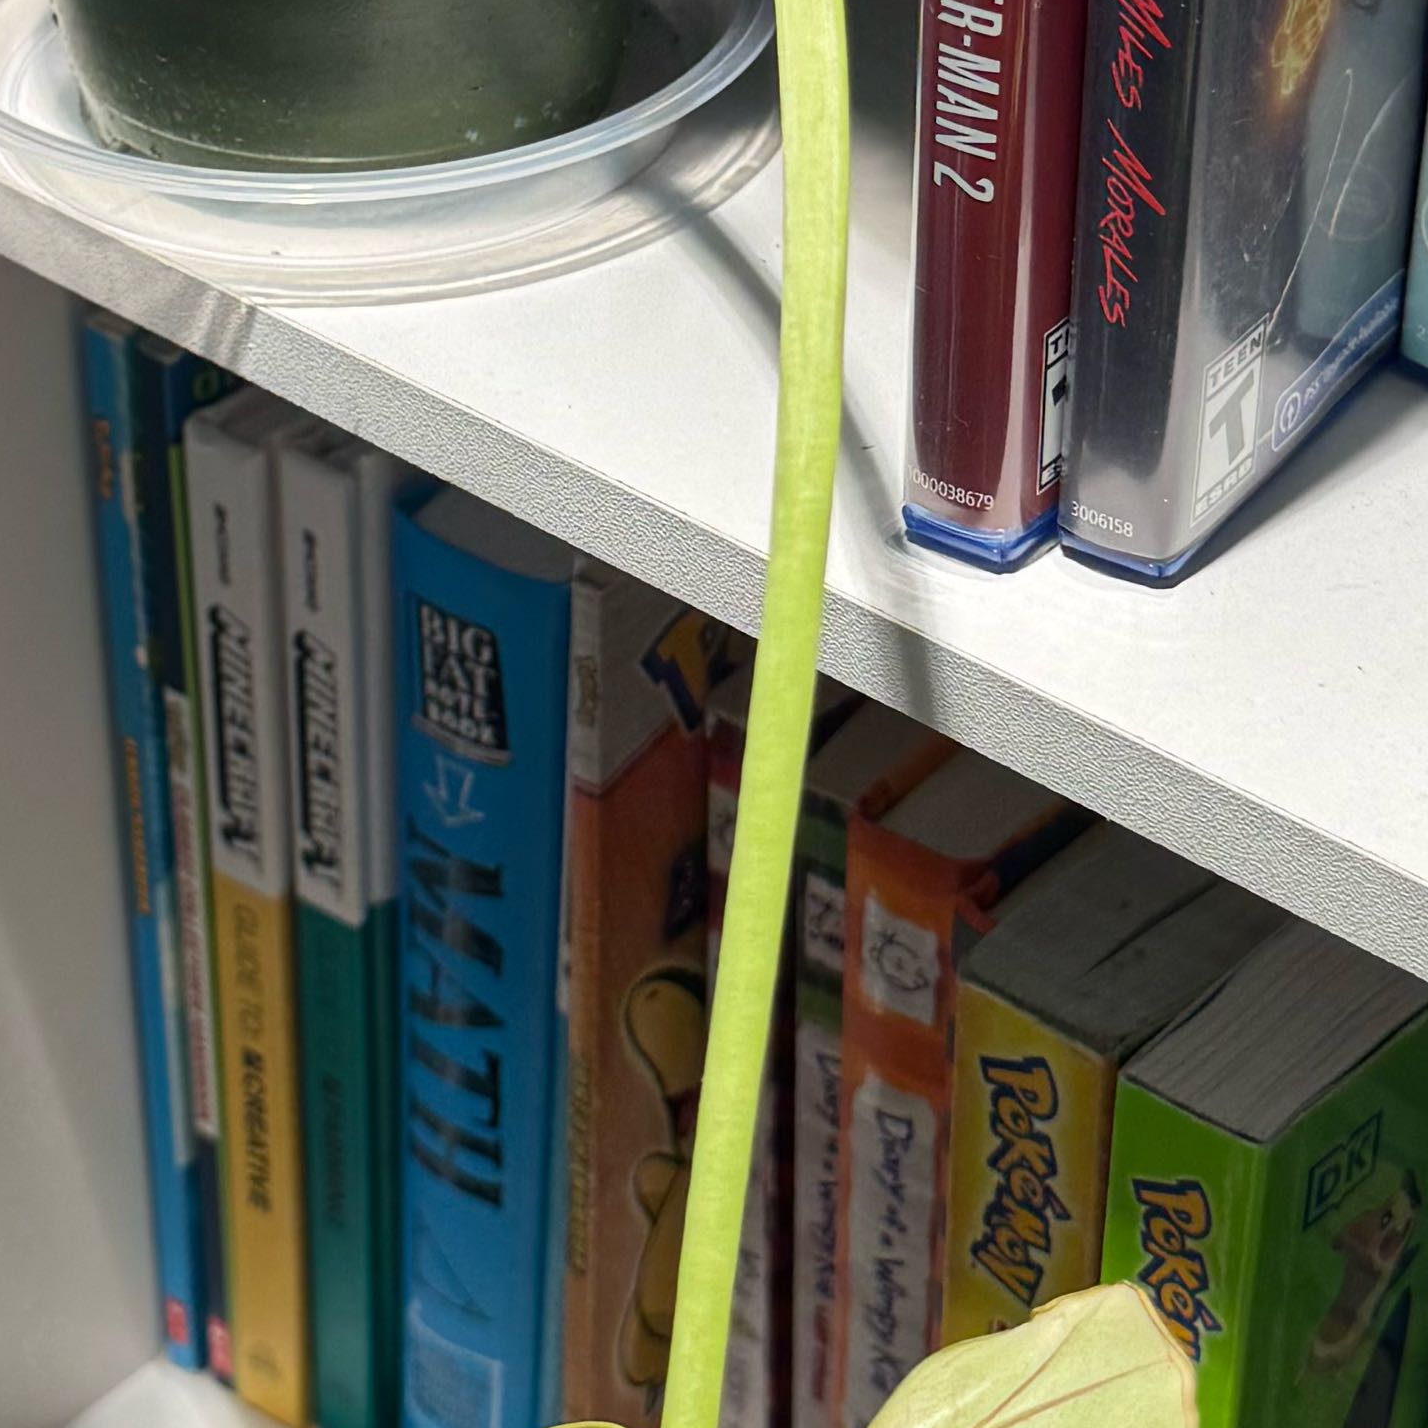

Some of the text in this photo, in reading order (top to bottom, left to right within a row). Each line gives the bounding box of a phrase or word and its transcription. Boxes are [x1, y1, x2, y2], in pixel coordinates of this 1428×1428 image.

[933, 161, 995, 203] 2
[1206, 328, 1263, 389] TEEN
[1208, 371, 1255, 474] T
[907, 465, 996, 511] 1000038679
[1194, 458, 1253, 518] ESRB
[1071, 500, 1134, 539] 3006158
[408, 816, 506, 1209] MATH
